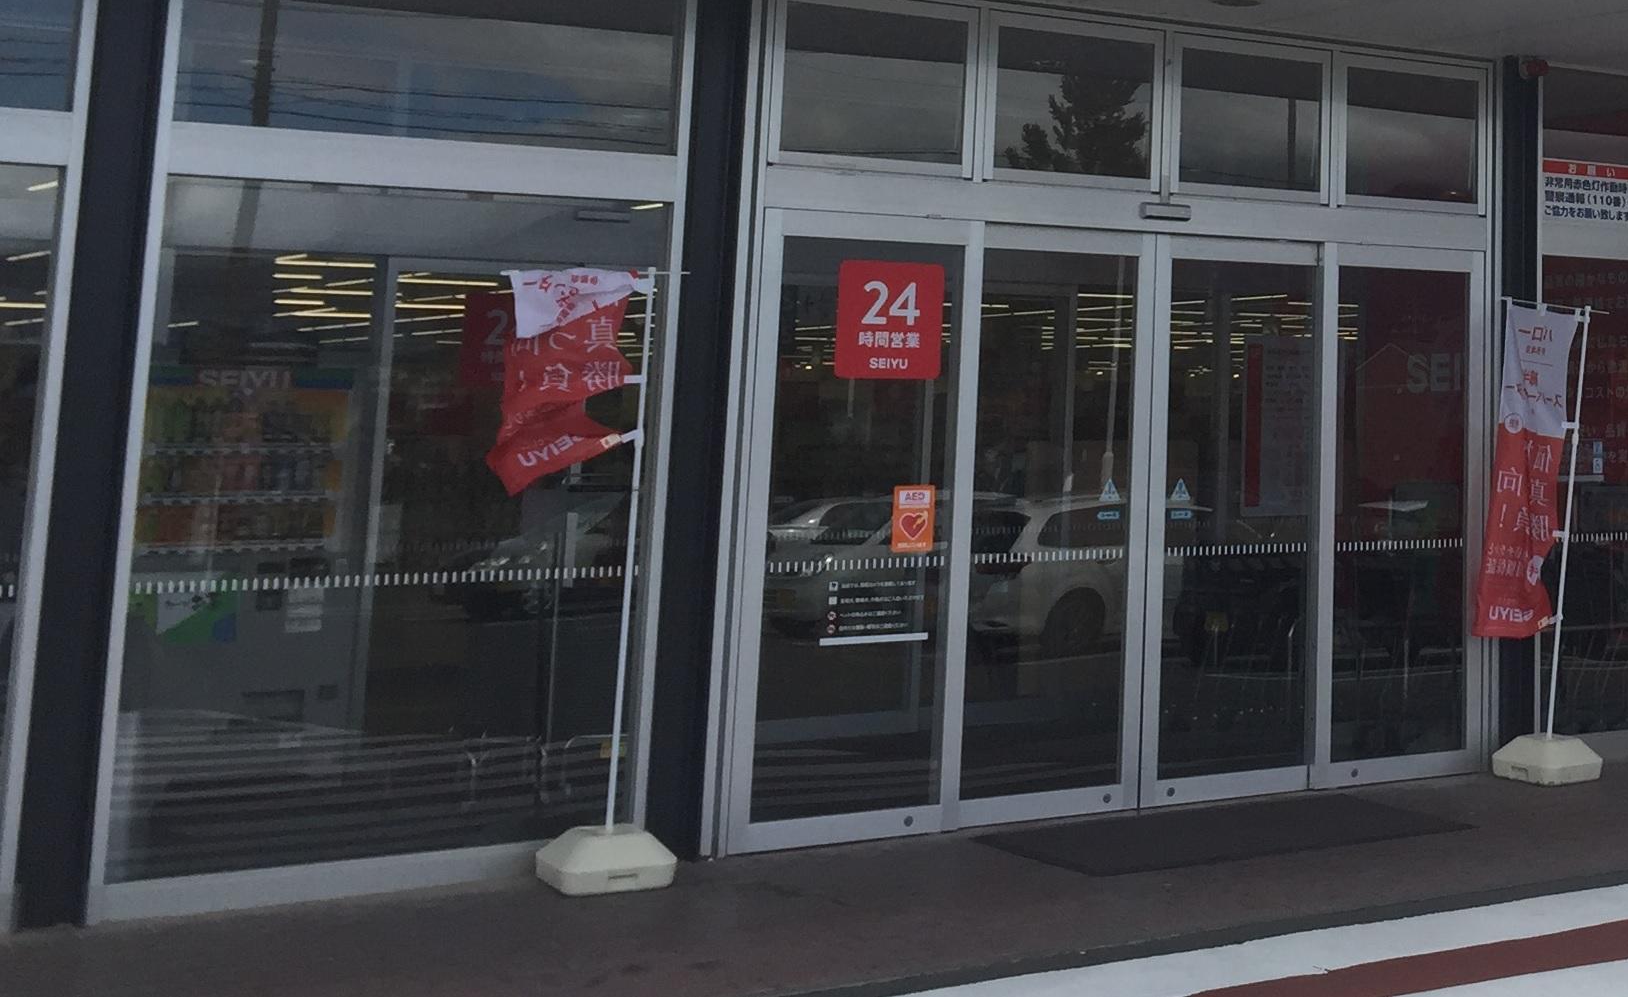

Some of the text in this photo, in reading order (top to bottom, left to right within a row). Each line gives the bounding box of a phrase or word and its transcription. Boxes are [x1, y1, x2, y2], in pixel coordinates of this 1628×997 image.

[861, 281, 920, 325] 24
[858, 331, 920, 348] 時間営業
[868, 358, 909, 369] SEIYU
[904, 491, 925, 501] AED
